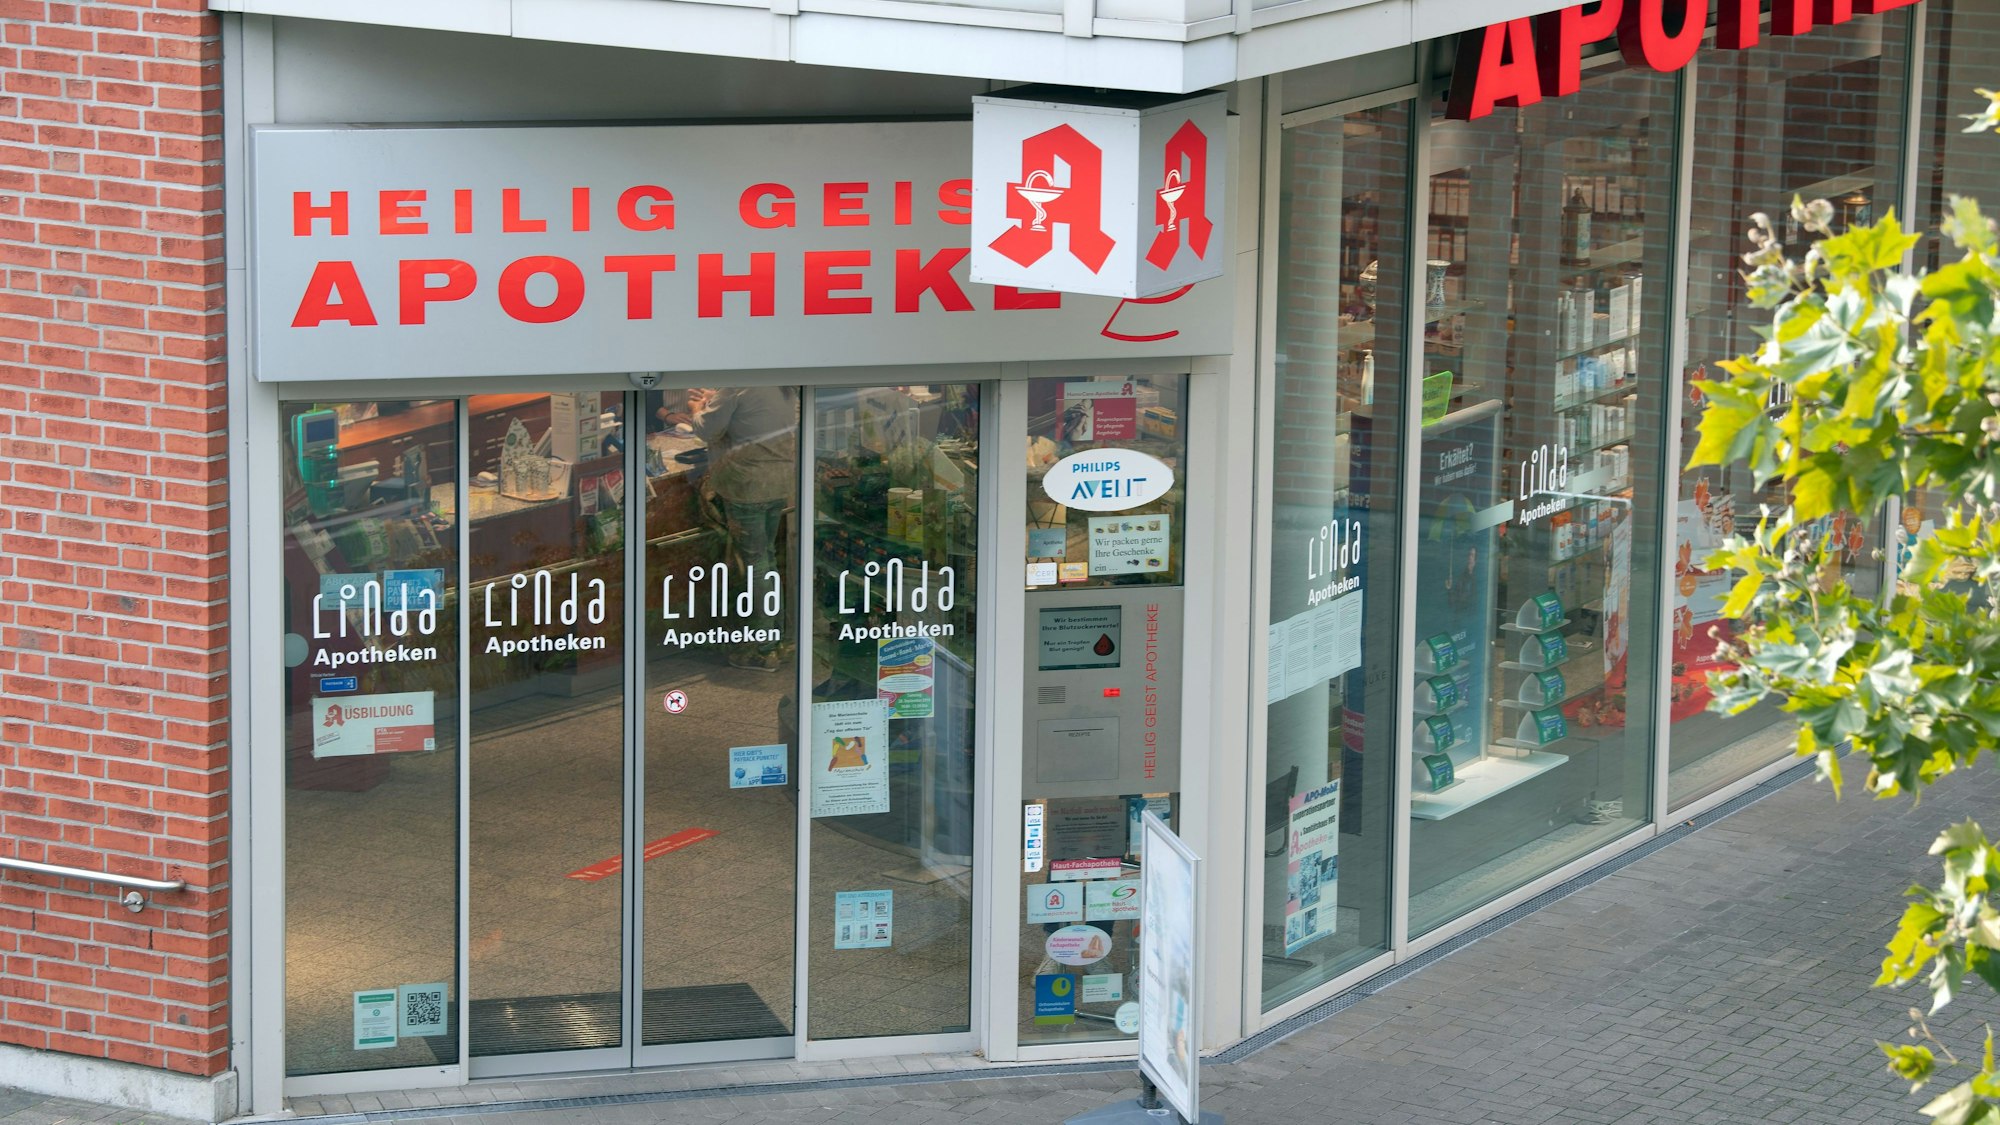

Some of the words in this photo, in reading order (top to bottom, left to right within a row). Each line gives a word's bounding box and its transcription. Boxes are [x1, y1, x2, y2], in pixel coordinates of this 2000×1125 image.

[293, 184, 675, 236] HEILIG
[739, 178, 972, 229] GEIS
[1072, 461, 1120, 474] PHILIPS
[1440, 443, 1474, 471] Erkältet?
[1519, 497, 1566, 526] Apotheken
[1095, 537, 1110, 547] Wir
[1112, 537, 1140, 548] packen
[1141, 537, 1163, 547] gerne
[1095, 549, 1110, 558] Ihre
[1112, 547, 1155, 557] Geschenke
[1094, 564, 1107, 572] ein
[1307, 575, 1360, 606] Apotheken
[663, 626, 781, 649] Apotheken
[839, 620, 955, 643] Apotheken
[1146, 603, 1159, 681] APOTHEKE
[313, 644, 437, 670] Apotheken
[485, 632, 606, 657] Apotheken
[1145, 685, 1157, 727] GEIST
[1144, 732, 1156, 779] HEILIG
[1053, 860, 1120, 870] Haut-Fachapotheke
